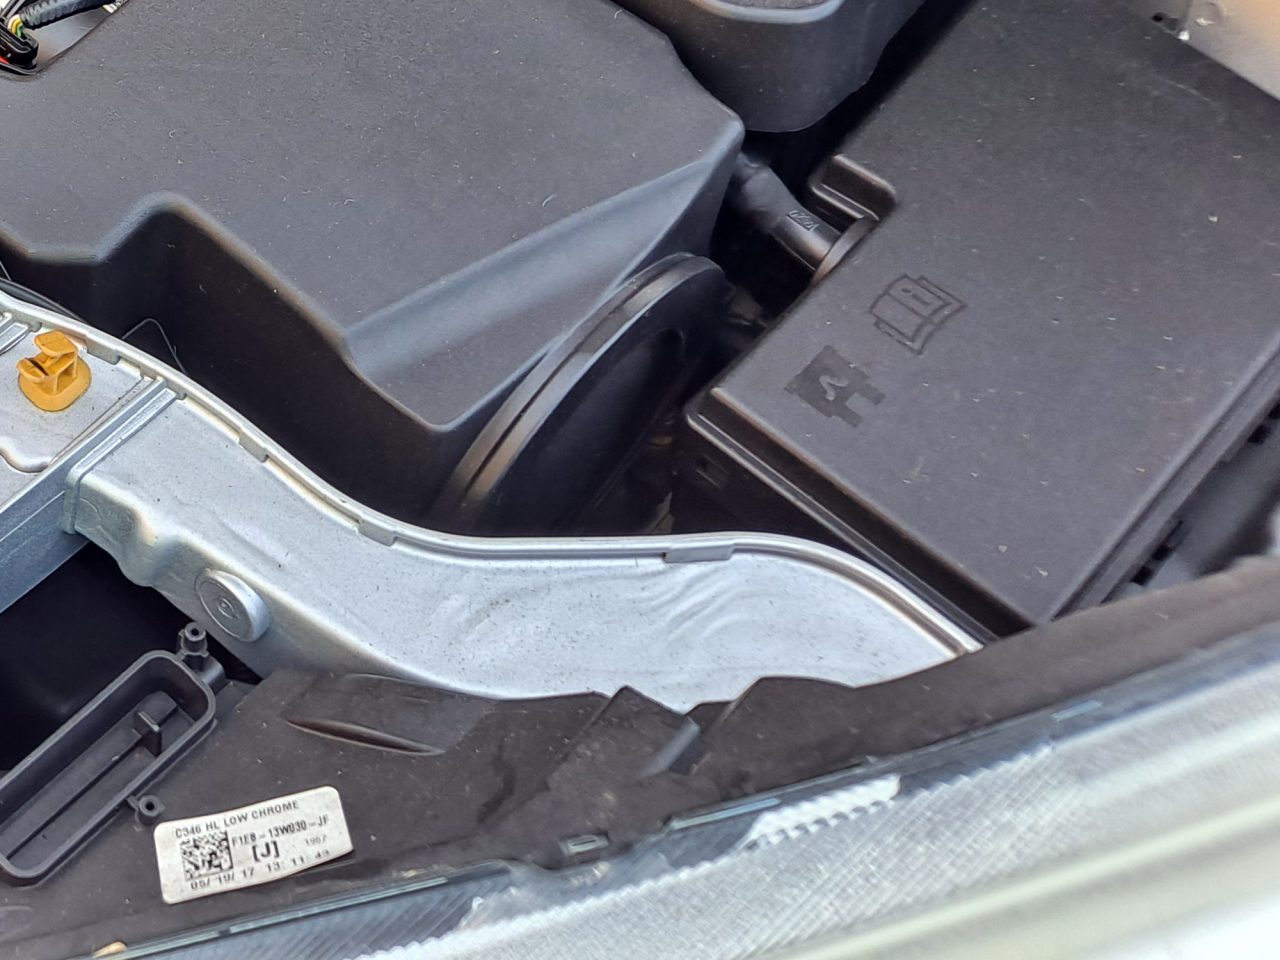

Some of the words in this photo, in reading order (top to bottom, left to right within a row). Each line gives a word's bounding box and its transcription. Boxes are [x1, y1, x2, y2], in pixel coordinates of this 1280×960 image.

[176, 825, 202, 838] C346
[206, 820, 220, 831] HL
[224, 813, 248, 827] LOW
[252, 802, 299, 820] CHROME
[252, 841, 280, 862] [J]
